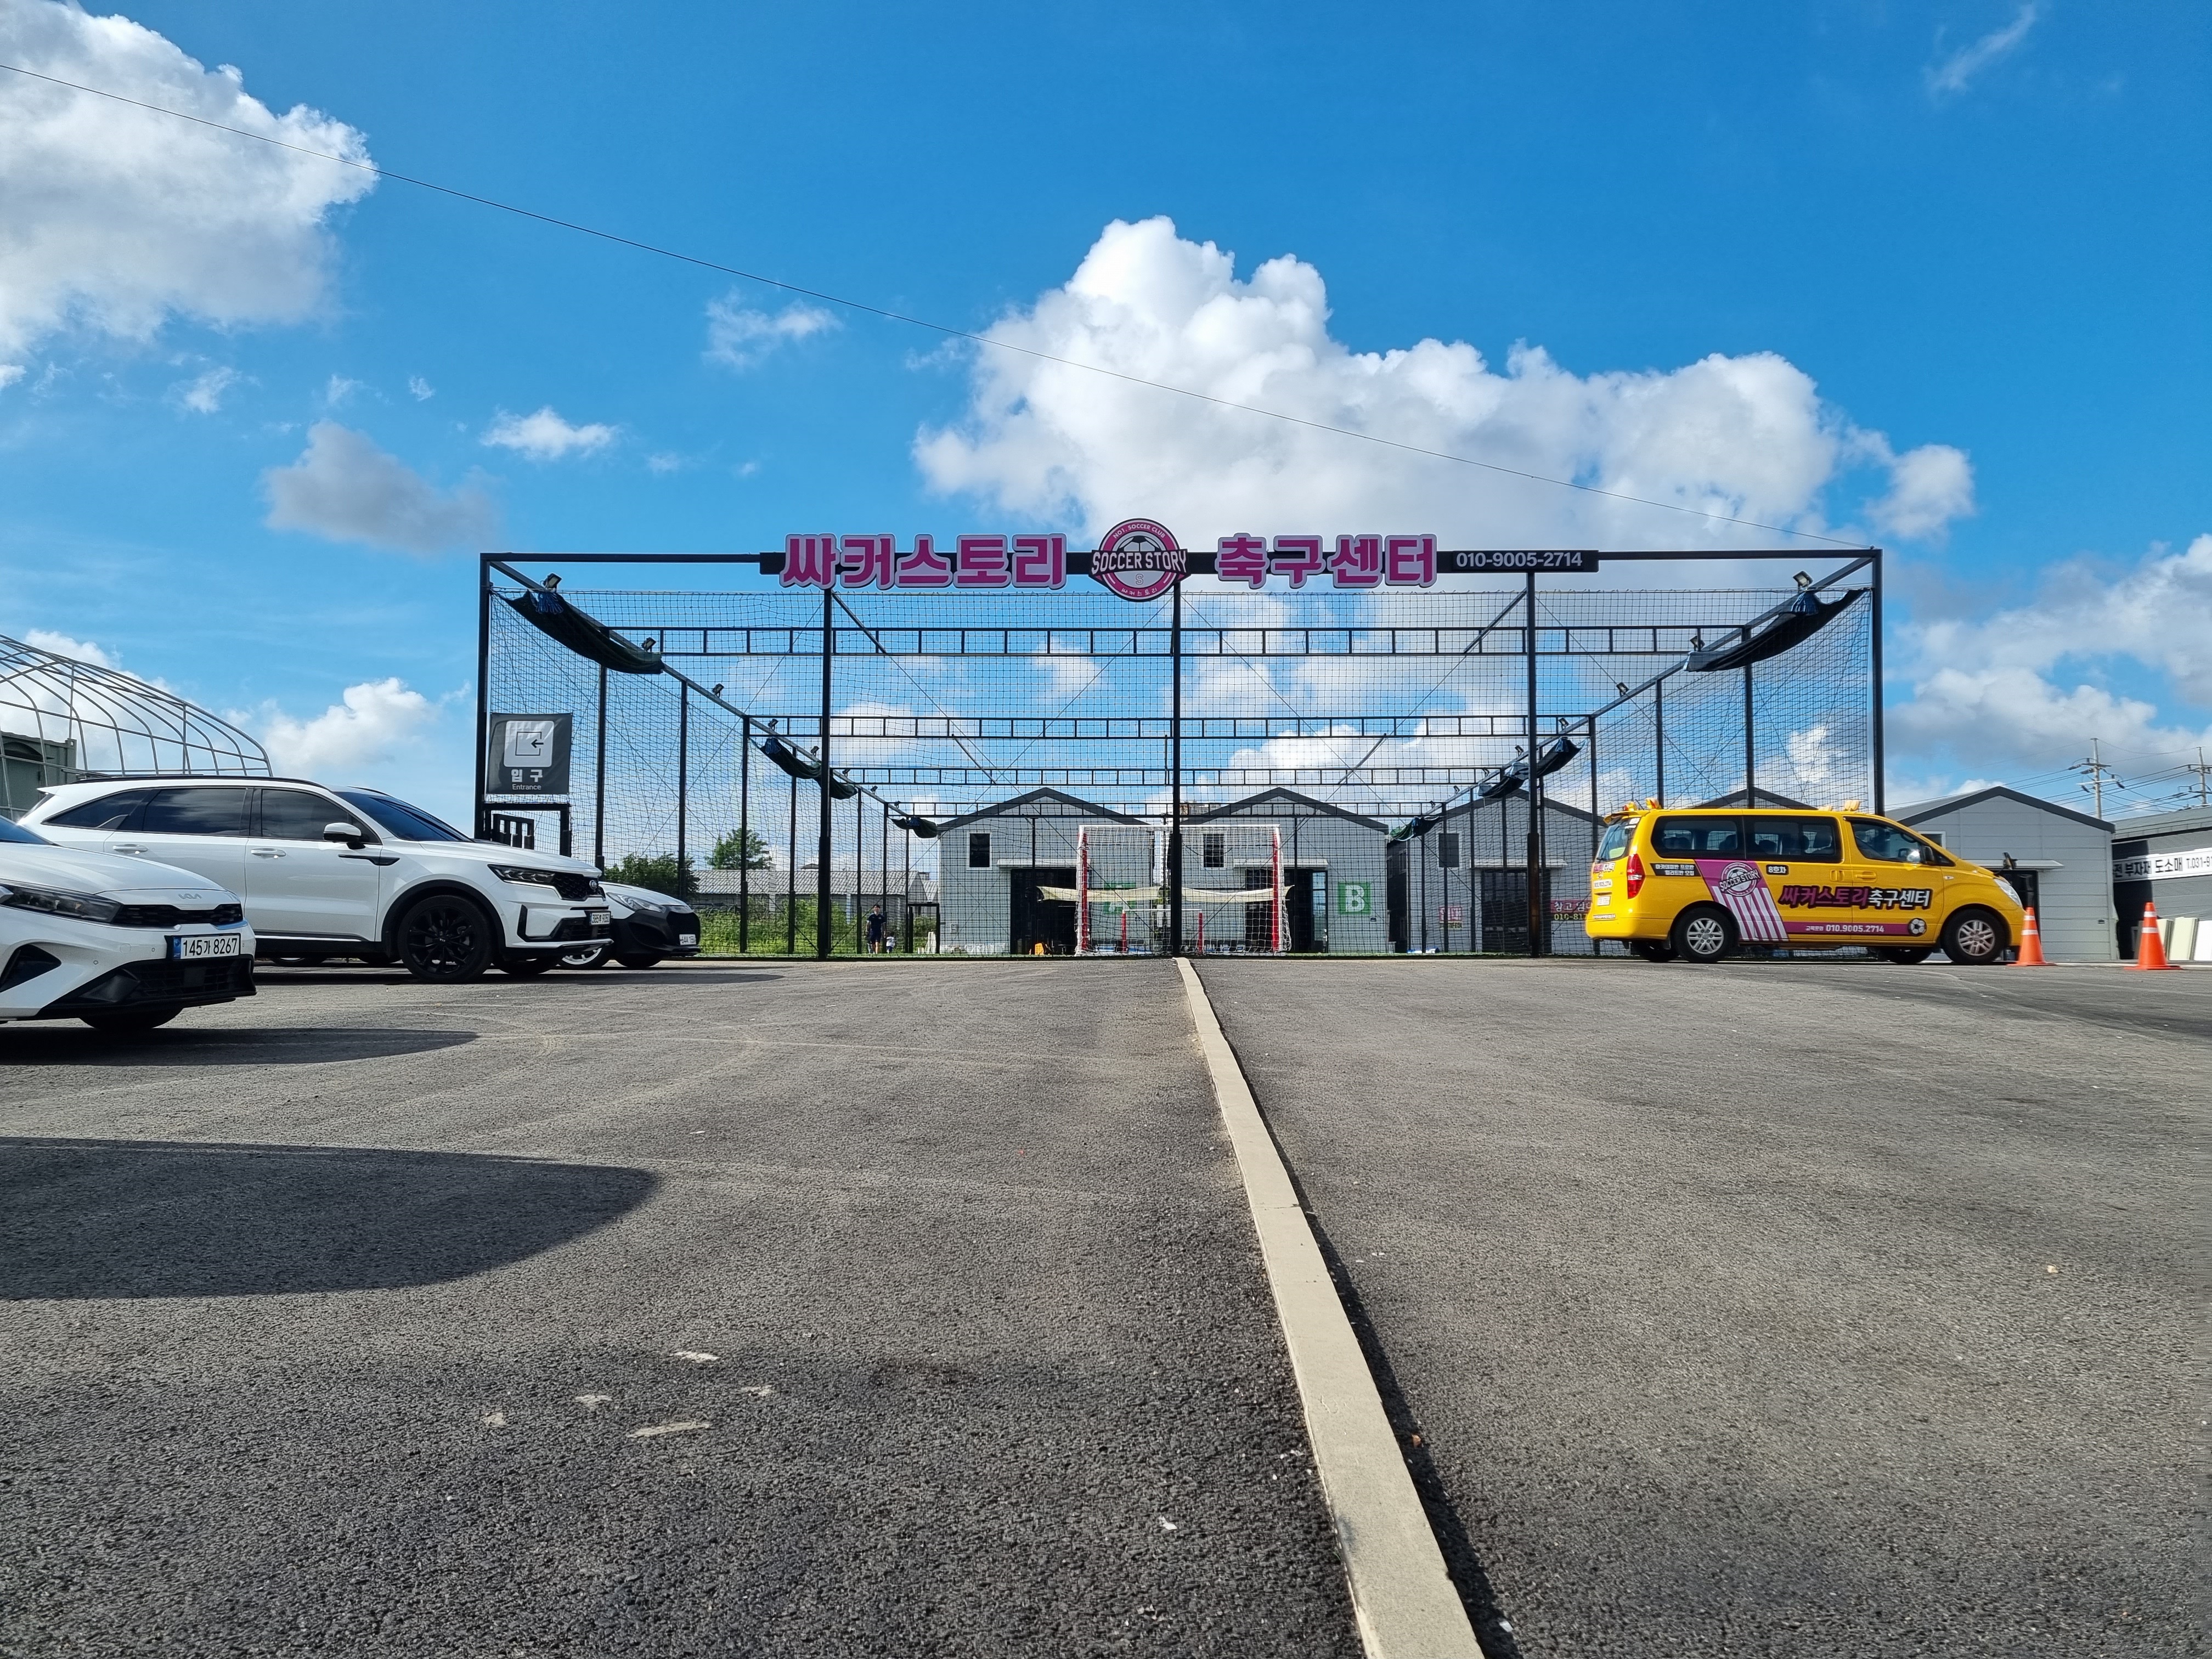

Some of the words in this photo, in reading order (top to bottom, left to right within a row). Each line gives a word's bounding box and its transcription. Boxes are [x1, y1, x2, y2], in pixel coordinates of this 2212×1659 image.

[1152, 527, 1166, 538] CLUB
[781, 535, 1065, 588] 싸커스토리
[1216, 535, 1436, 588] 축구센터
[1091, 551, 1142, 575] SOCCER
[1146, 550, 1187, 573] STORY
[1456, 552, 1582, 568] 010-9005-2714
[1135, 573, 1144, 585] S
[2155, 857, 2183, 873] 도소매
[1719, 876, 1742, 892] SOCCER
[1740, 868, 1760, 882] STORY
[1345, 885, 1365, 912] B
[1554, 901, 1573, 912] 창고
[1826, 924, 1885, 933] 010.9005.2714
[183, 940, 211, 956] 145가
[213, 938, 238, 955] 8267
